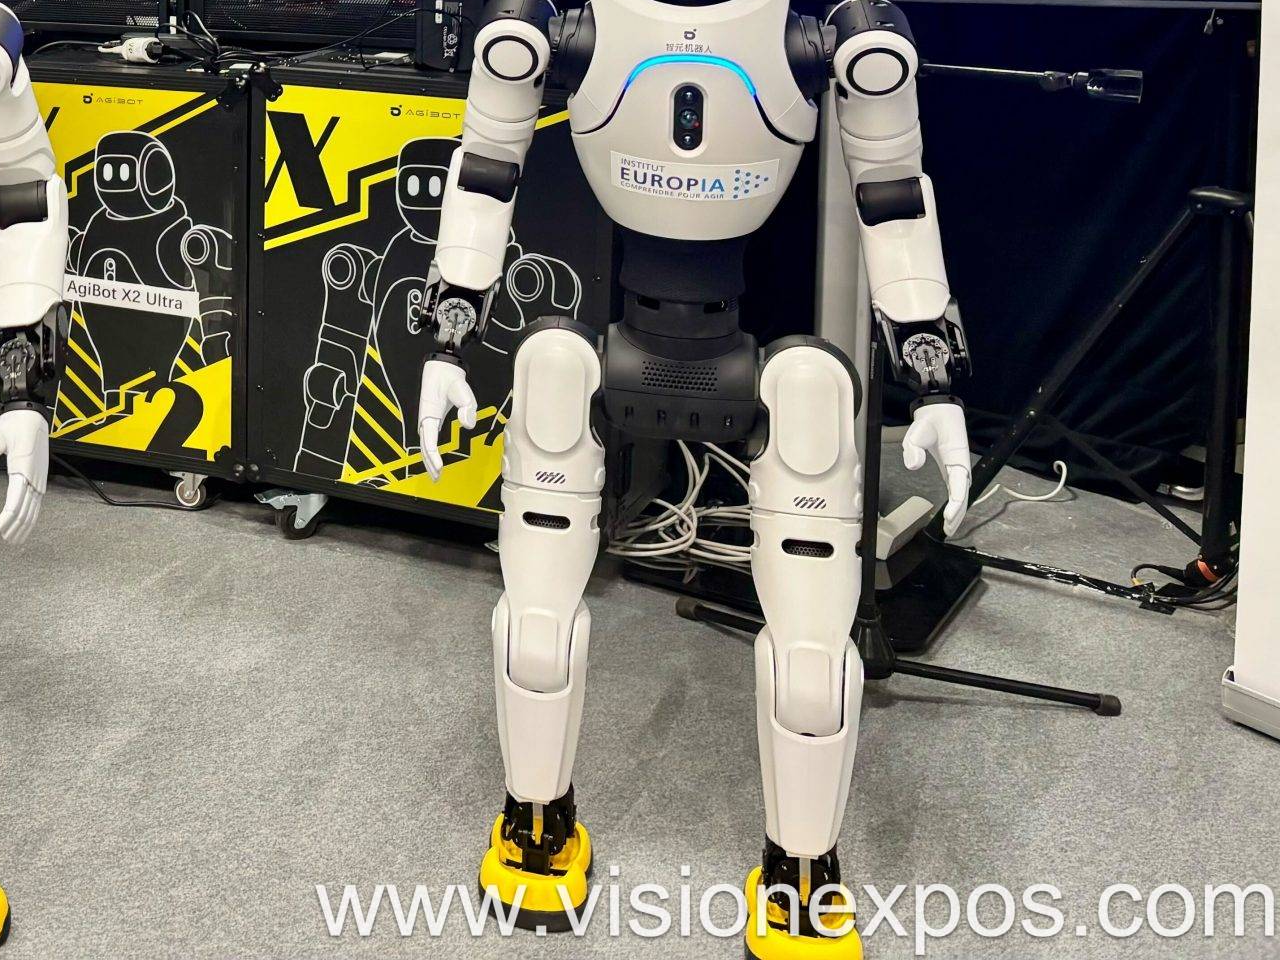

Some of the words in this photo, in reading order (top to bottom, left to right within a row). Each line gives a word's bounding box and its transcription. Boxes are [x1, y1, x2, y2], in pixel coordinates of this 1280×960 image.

[620, 158, 665, 173] INSTITUT
[620, 166, 725, 193] EUROPIA
[620, 181, 675, 197] COMPRENDRE
[67, 280, 117, 298] AgiBot
[122, 288, 141, 303] X2
[146, 292, 183, 310] Ultra
